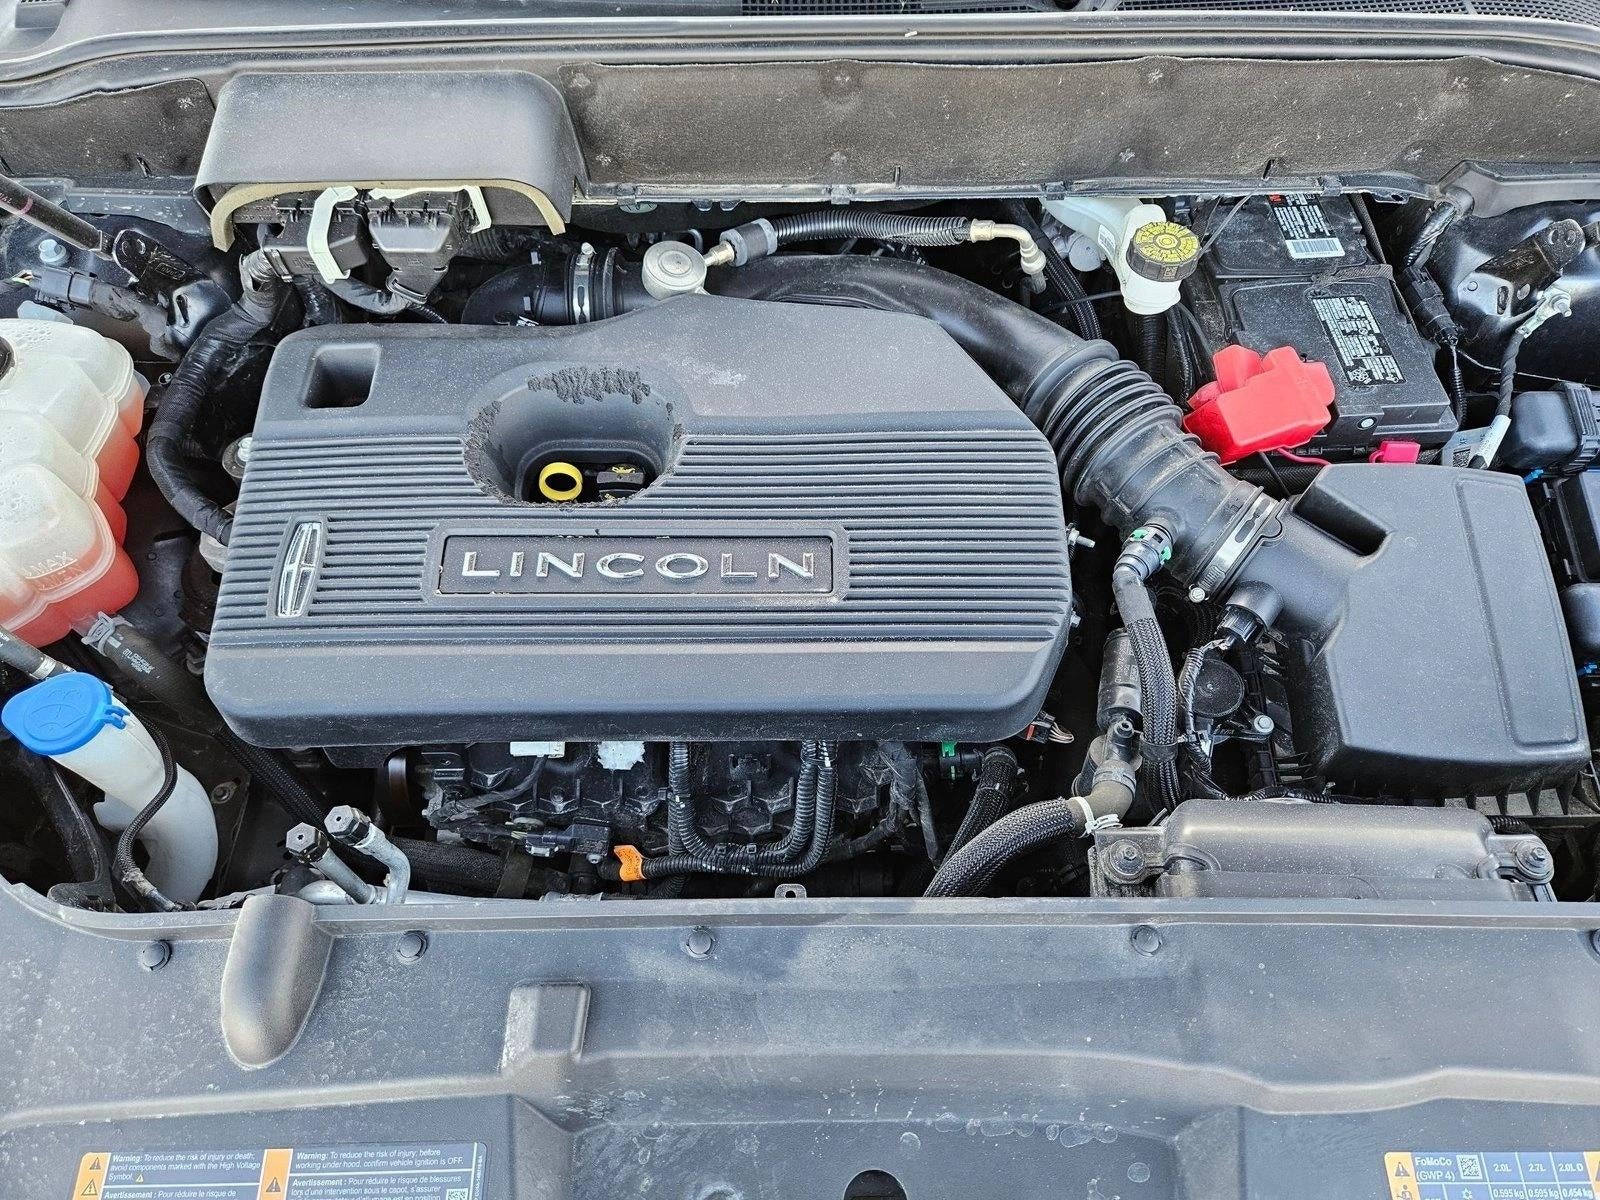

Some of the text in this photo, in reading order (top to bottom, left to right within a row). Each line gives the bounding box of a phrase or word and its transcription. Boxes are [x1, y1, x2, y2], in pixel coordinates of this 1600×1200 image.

[462, 551, 816, 579] LINCOLN
[113, 1154, 142, 1163] Warning:
[144, 1153, 152, 1161] To
[153, 1153, 175, 1161] reduce
[200, 1152, 207, 1160] of
[208, 1152, 225, 1161] injury
[297, 1152, 328, 1161] Warning:
[330, 1151, 339, 1159] To
[340, 1150, 363, 1159] reduce
[364, 1150, 375, 1158] the
[376, 1149, 388, 1157] risk
[390, 1149, 397, 1157] of
[419, 1148, 441, 1157] before
[128, 1163, 167, 1172] components
[168, 1162, 192, 1170] marked
[193, 1161, 206, 1169] with
[207, 1161, 217, 1169] the
[219, 1161, 235, 1171] High
[237, 1160, 260, 1171] Voltage
[296, 1160, 322, 1170] working
[323, 1160, 342, 1168] under
[364, 1159, 388, 1167] confirm
[390, 1158, 413, 1166] vehicle
[414, 1158, 439, 1168] ignition
[440, 1157, 446, 1165] is
[1415, 1156, 1452, 1166] FoMoCo
[1493, 1163, 1512, 1172] 2.0L
[1528, 1163, 1546, 1172] 2.7L
[1558, 1163, 1576, 1172] 2.0L
[292, 1178, 343, 1187] Avertissement
[349, 1177, 365, 1186] Pour
[366, 1176, 389, 1185] réduire
[398, 1176, 419, 1186] risque
[420, 1175, 429, 1183] de
[430, 1175, 462, 1183] blessures
[1416, 1170, 1455, 1182] (GWP 4)
[104, 1190, 153, 1199] Avertissement
[158, 1190, 174, 1198] Pour
[175, 1189, 197, 1198] réduire
[199, 1189, 205, 1197] le
[206, 1189, 227, 1199] risque
[228, 1188, 237, 1197] de
[291, 1188, 304, 1196] lors
[324, 1186, 363, 1196] intervention
[381, 1185, 388, 1193] le
[1515, 1189, 1525, 1200] kg
[1549, 1189, 1560, 1200] kg
[1584, 1189, 1594, 1200] kg
